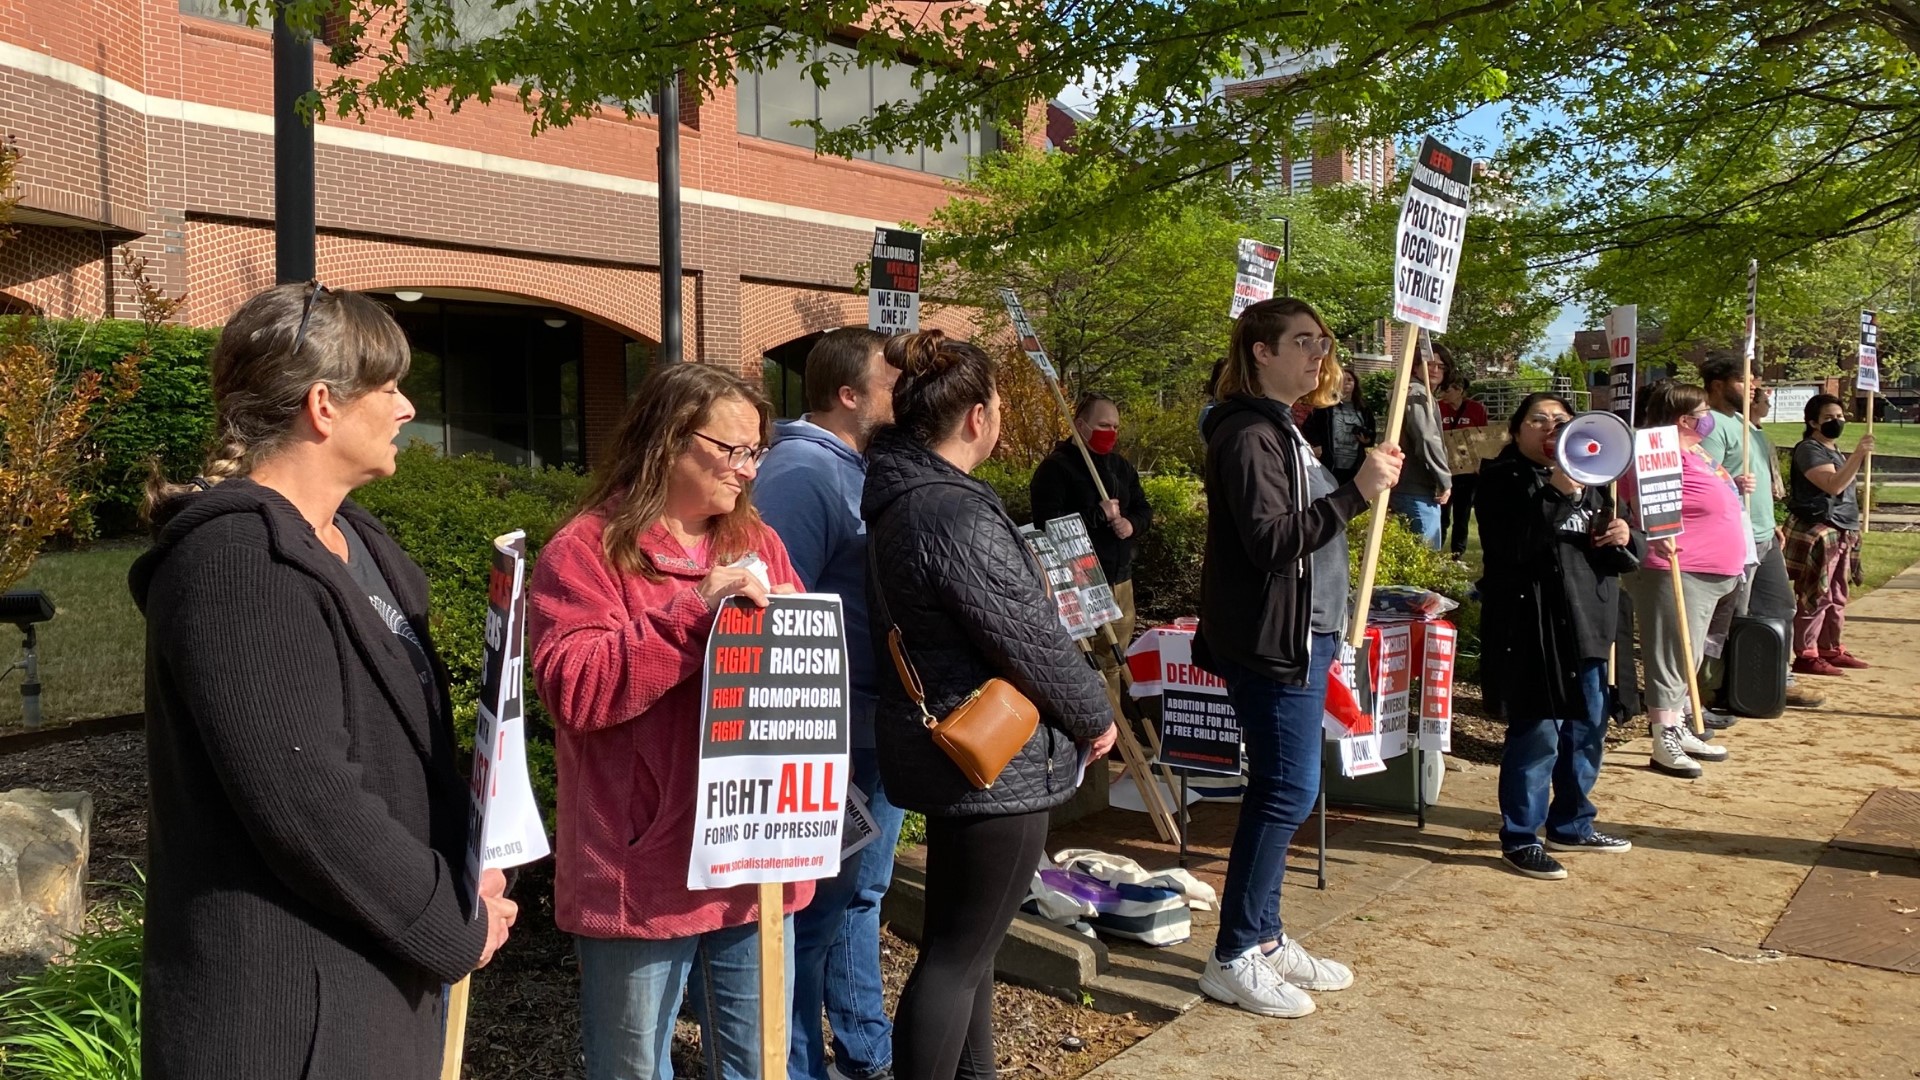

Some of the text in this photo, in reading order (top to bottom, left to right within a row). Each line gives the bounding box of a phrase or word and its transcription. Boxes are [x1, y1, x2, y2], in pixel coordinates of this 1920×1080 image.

[1404, 196, 1462, 243] PROTEST!
[1401, 231, 1454, 274] OCCUPY!
[1399, 266, 1445, 305] STRIKE!
[878, 291, 910, 308] WE NEED
[881, 309, 908, 326] ONE OF
[1648, 432, 1664, 450] WE
[1638, 450, 1678, 472] DEMAND
[1648, 504, 1662, 514] FREE
[718, 608, 838, 637] FIGHT SEXISM
[715, 647, 840, 674] FIGHT RACISM
[1166, 662, 1228, 688] DEMAN
[712, 687, 842, 709] FIGHT HOMOPHOBIA
[1167, 698, 1206, 713] ABORTION
[712, 720, 838, 742] FIGHT XENOPHOBIA
[1164, 711, 1240, 732] MEDICARE FOR ALL,
[1380, 715, 1407, 735] CHILDCARE
[1166, 725, 1240, 744] & FREE CHILD CARE
[706, 762, 839, 820] FIGHT ALL
[704, 820, 838, 846] FORMS OF OPPRESSION
[710, 856, 824, 875] www.socialistalternative.org
